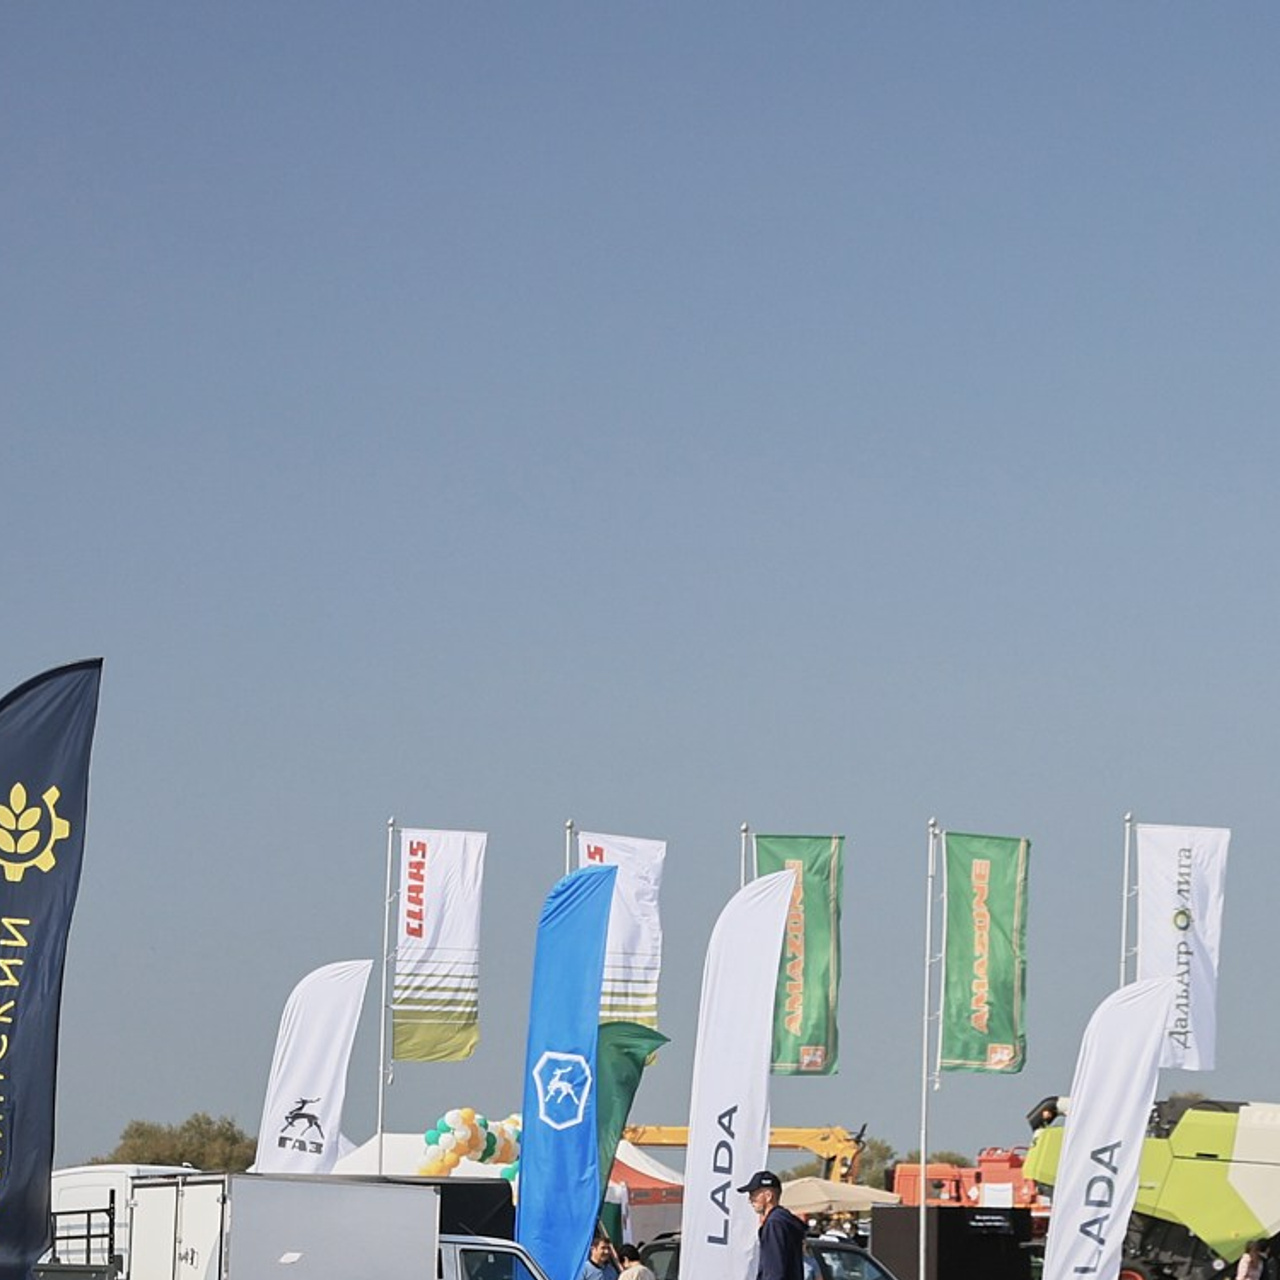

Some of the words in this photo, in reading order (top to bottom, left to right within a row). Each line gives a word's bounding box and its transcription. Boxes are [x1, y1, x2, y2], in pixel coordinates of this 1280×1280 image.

[406, 840, 427, 938] CLAAS
[971, 859, 990, 1035] AMAZONE
[278, 1136, 323, 1154] ГАЗ
[707, 1105, 738, 1245] LADA
[1074, 1140, 1122, 1276] LADA
